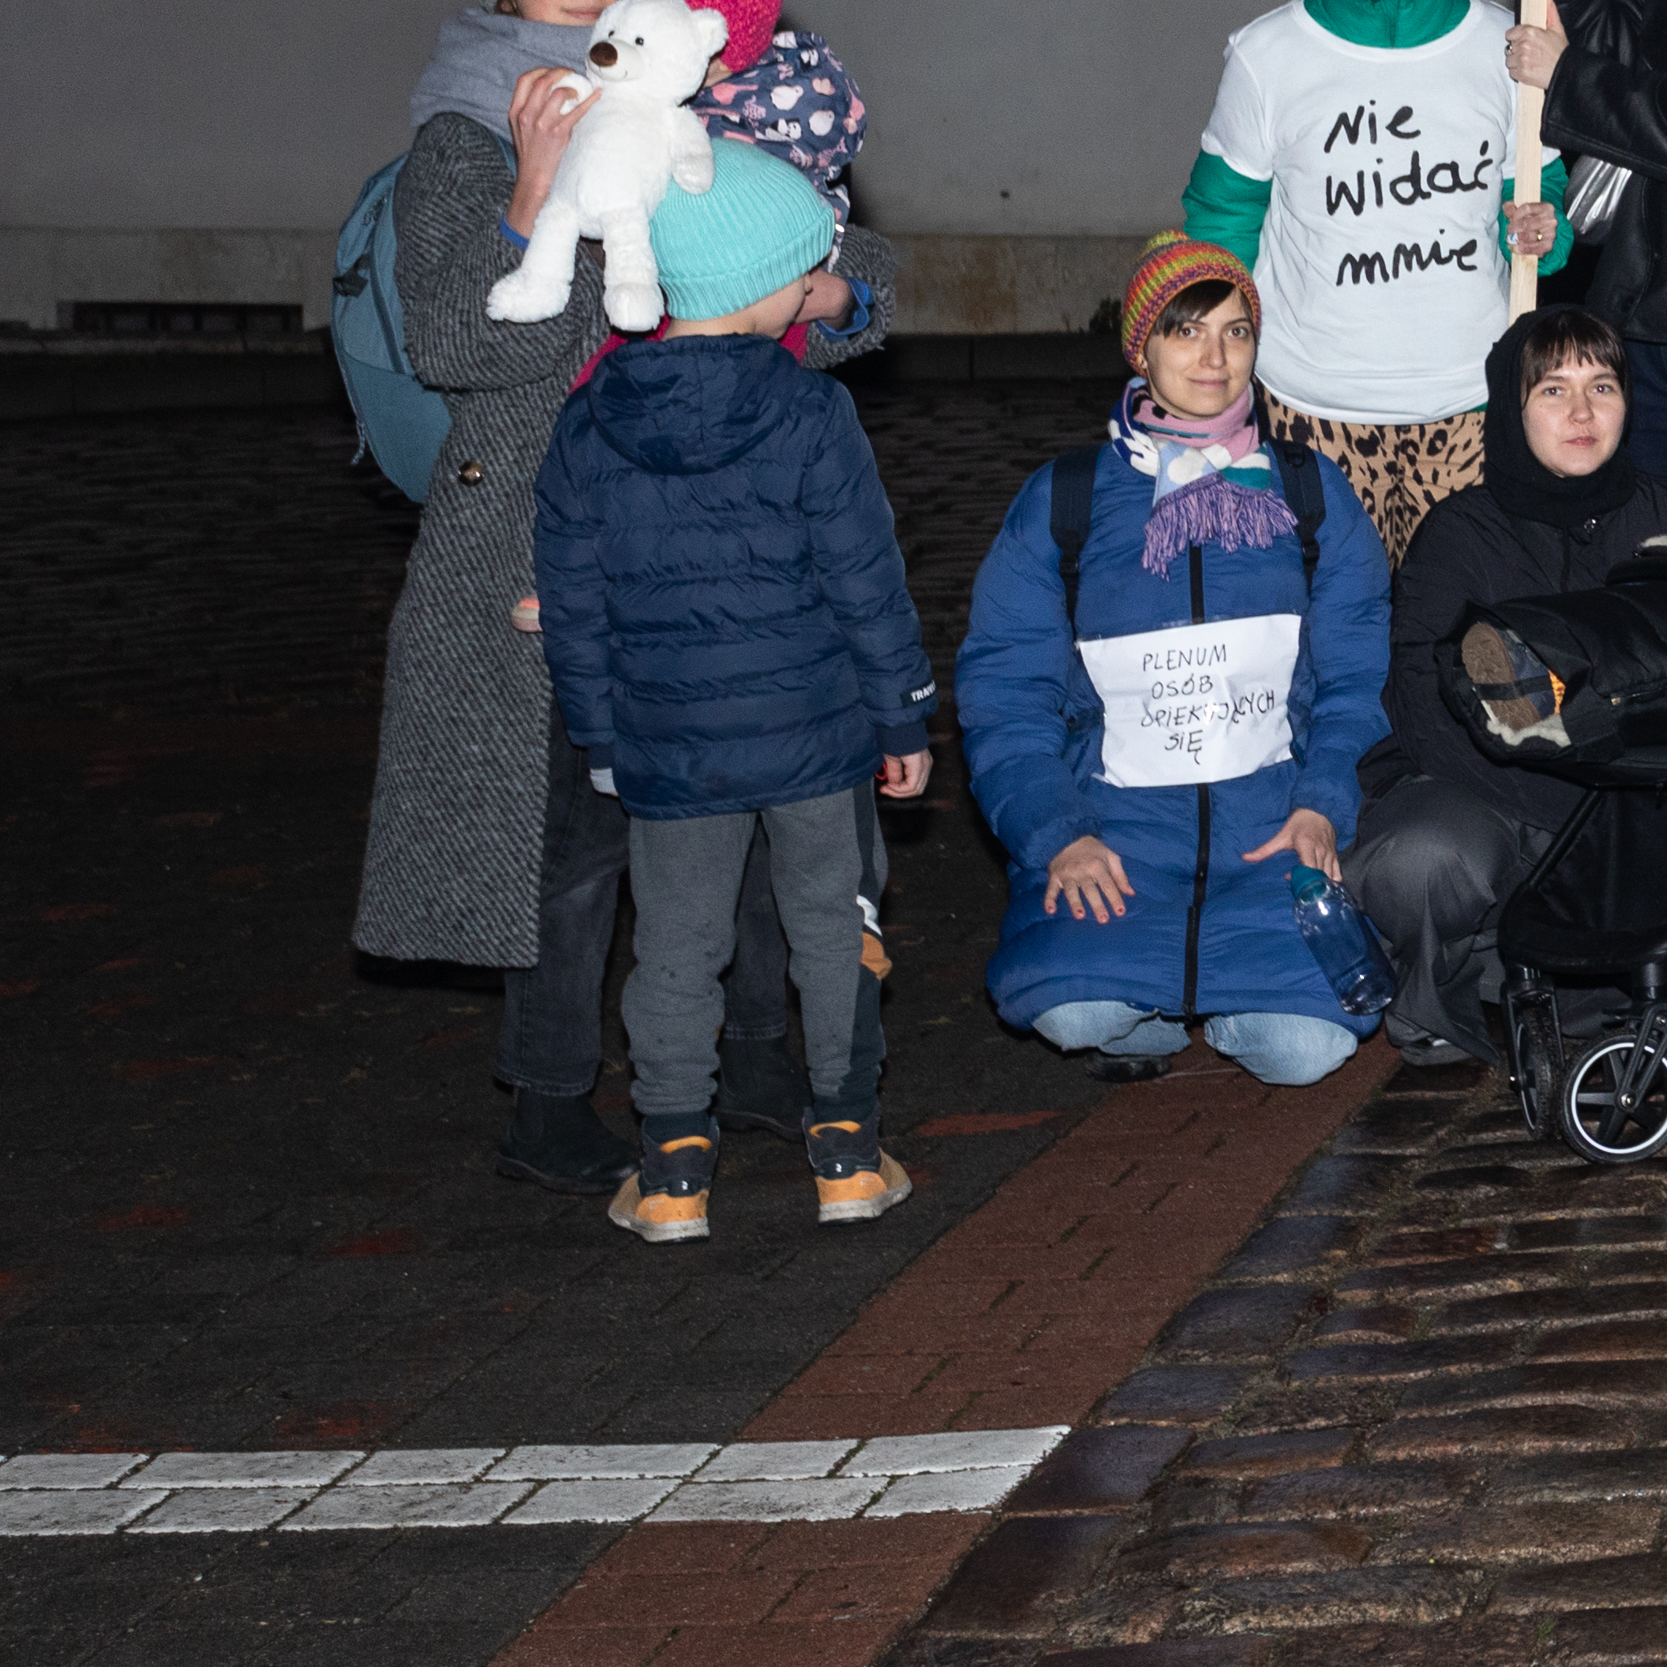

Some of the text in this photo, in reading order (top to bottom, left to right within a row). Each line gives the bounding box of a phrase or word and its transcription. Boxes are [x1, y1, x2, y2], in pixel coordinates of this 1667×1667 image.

[1324, 100, 1421, 153] Nie
[1337, 229, 1478, 287] mnie
[1142, 643, 1227, 672] PLENUM
[1151, 673, 1214, 700] OSÓB
